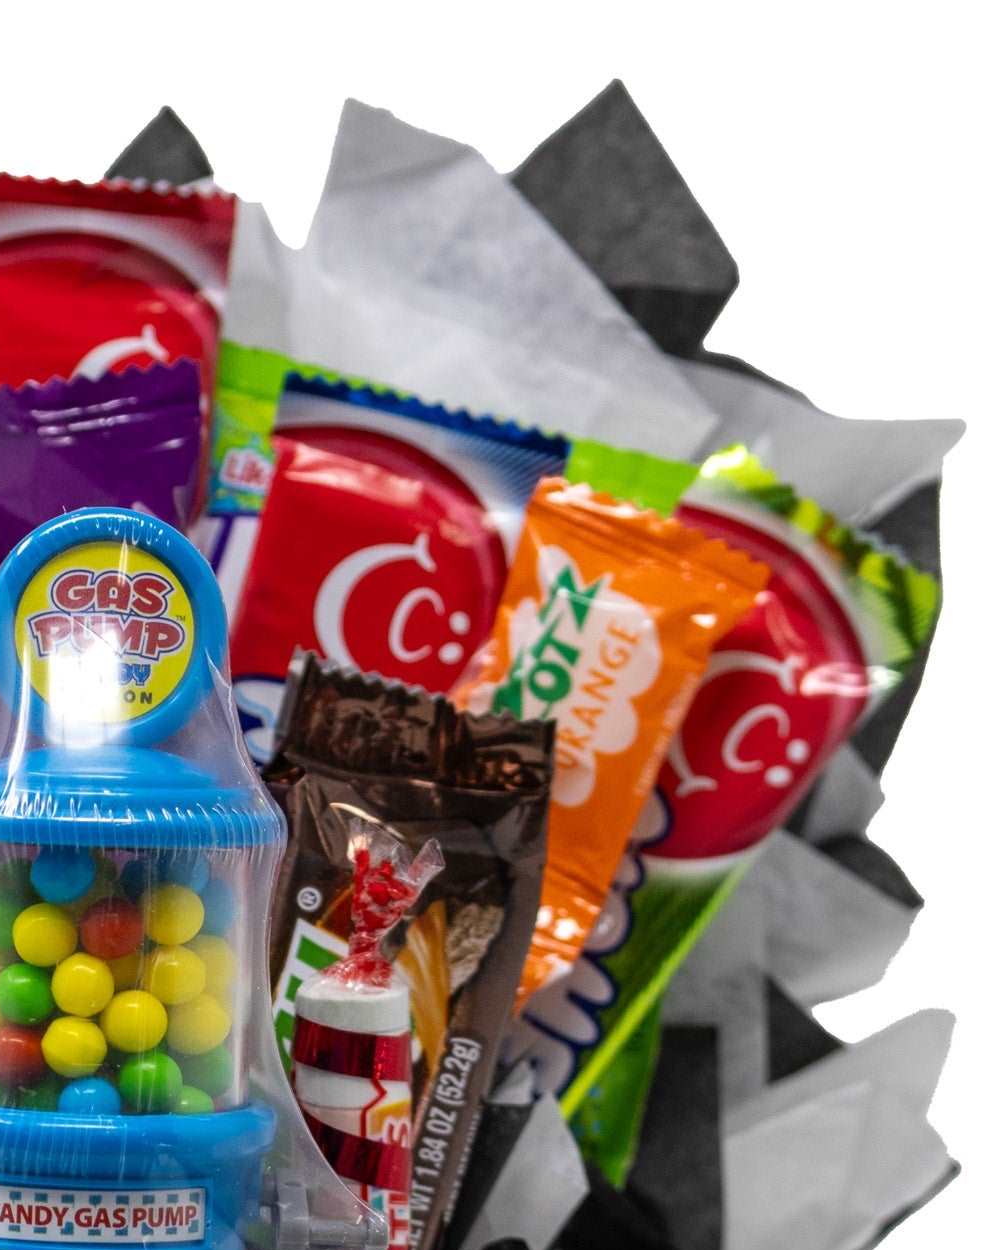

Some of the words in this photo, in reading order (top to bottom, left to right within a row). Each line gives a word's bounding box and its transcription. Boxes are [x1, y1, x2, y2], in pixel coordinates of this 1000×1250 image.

[50, 569, 174, 617] GAS
[27, 611, 186, 661] PUMP
[436, 1036, 483, 1108] (52.2g)
[425, 1105, 457, 1135] OZ
[415, 1140, 449, 1178] 1.84
[411, 1180, 436, 1212] WT
[73, 1206, 127, 1229] GAS
[131, 1205, 198, 1229] PUMP
